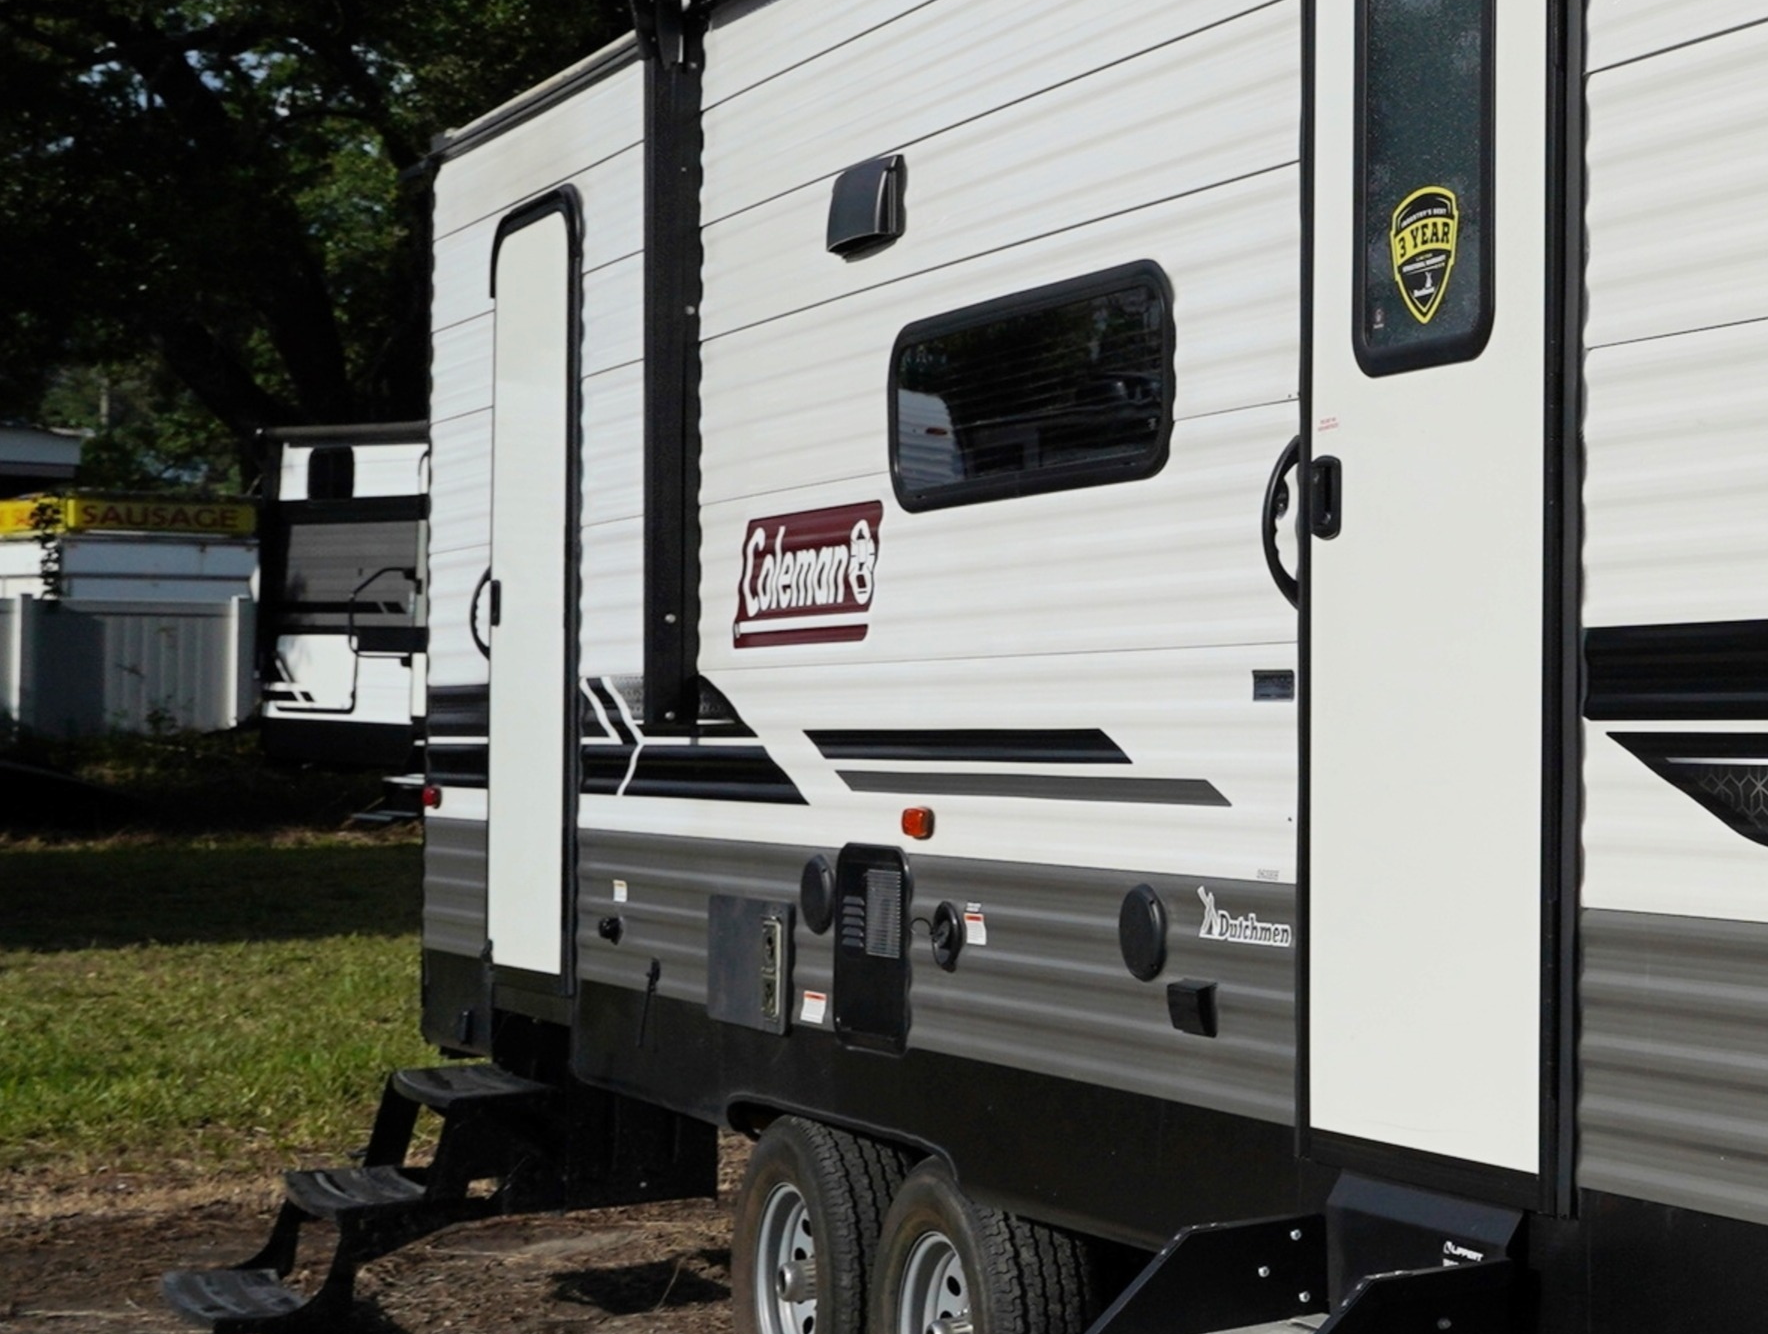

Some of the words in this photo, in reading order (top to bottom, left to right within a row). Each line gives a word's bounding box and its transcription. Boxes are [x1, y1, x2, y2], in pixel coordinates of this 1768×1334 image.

[1398, 236, 1406, 258] 3
[1410, 221, 1450, 249] YEAR
[82, 505, 238, 528] SAUSAGE
[743, 526, 849, 617] Coleman
[1219, 912, 1290, 945] Dutchmen
